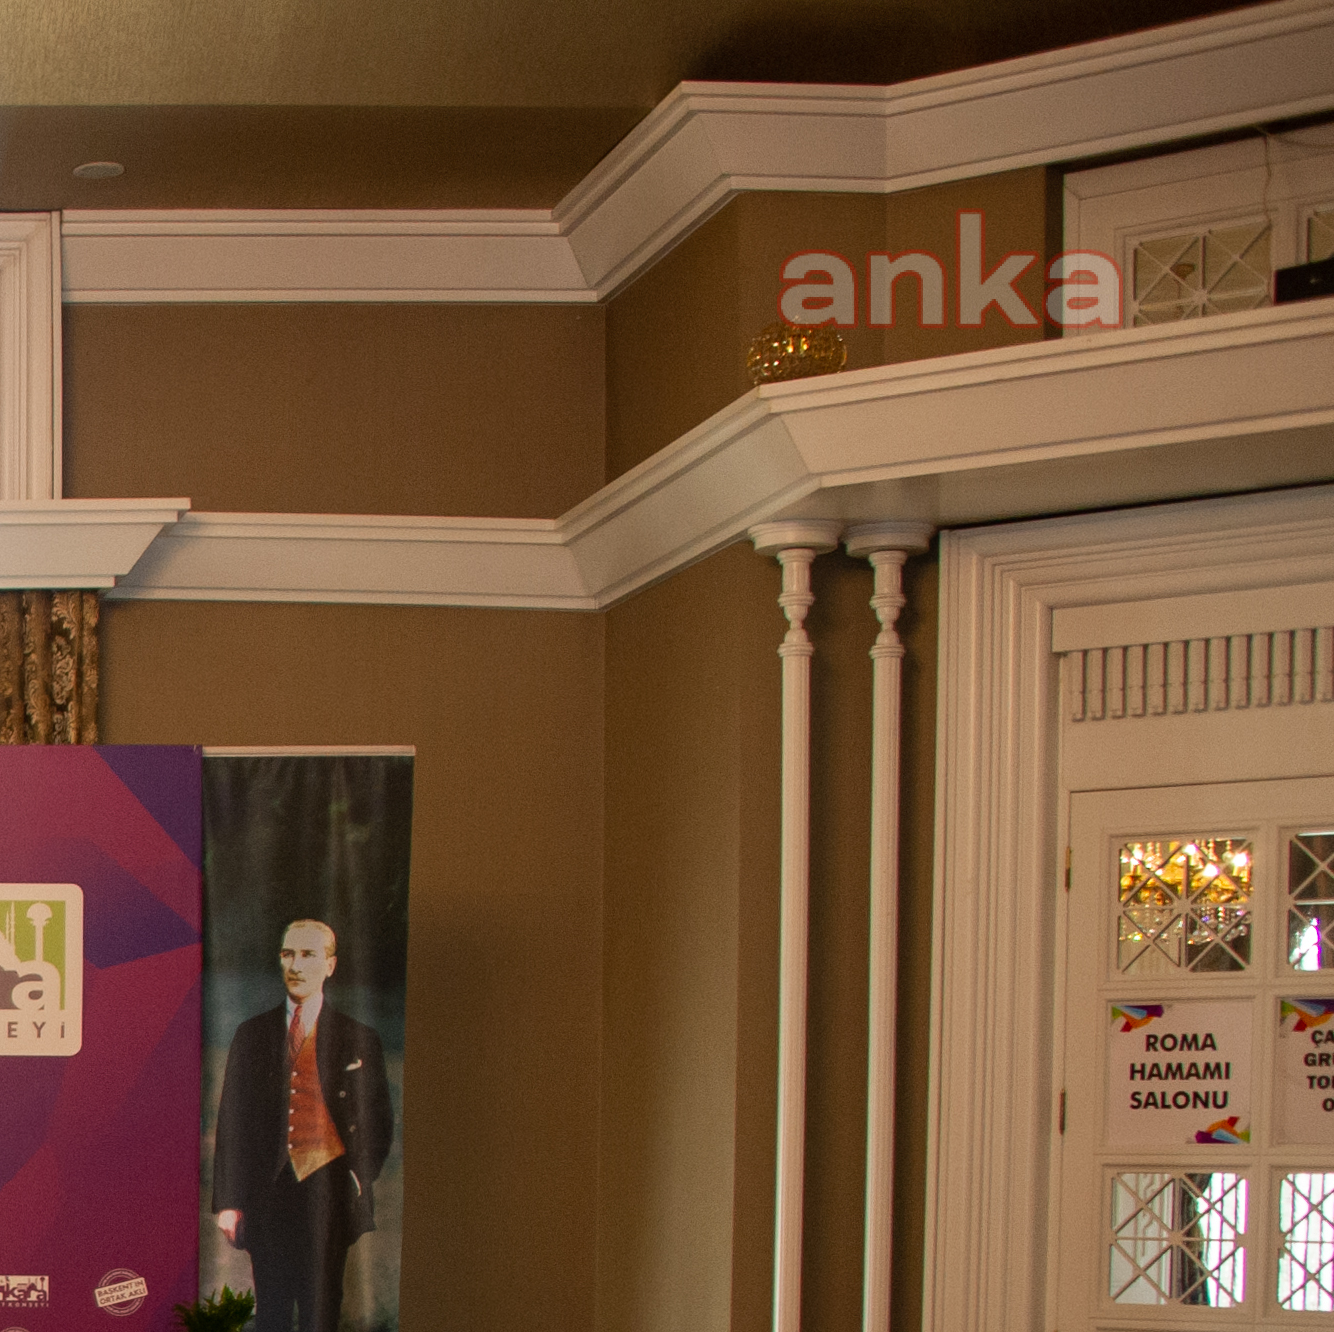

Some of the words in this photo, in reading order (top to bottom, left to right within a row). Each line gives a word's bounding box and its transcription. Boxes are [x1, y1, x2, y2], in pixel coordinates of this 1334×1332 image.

[1145, 1033, 1217, 1052] ROMA
[1129, 1062, 1231, 1080] HAMAMI
[1130, 1091, 1229, 1109] SALONU
